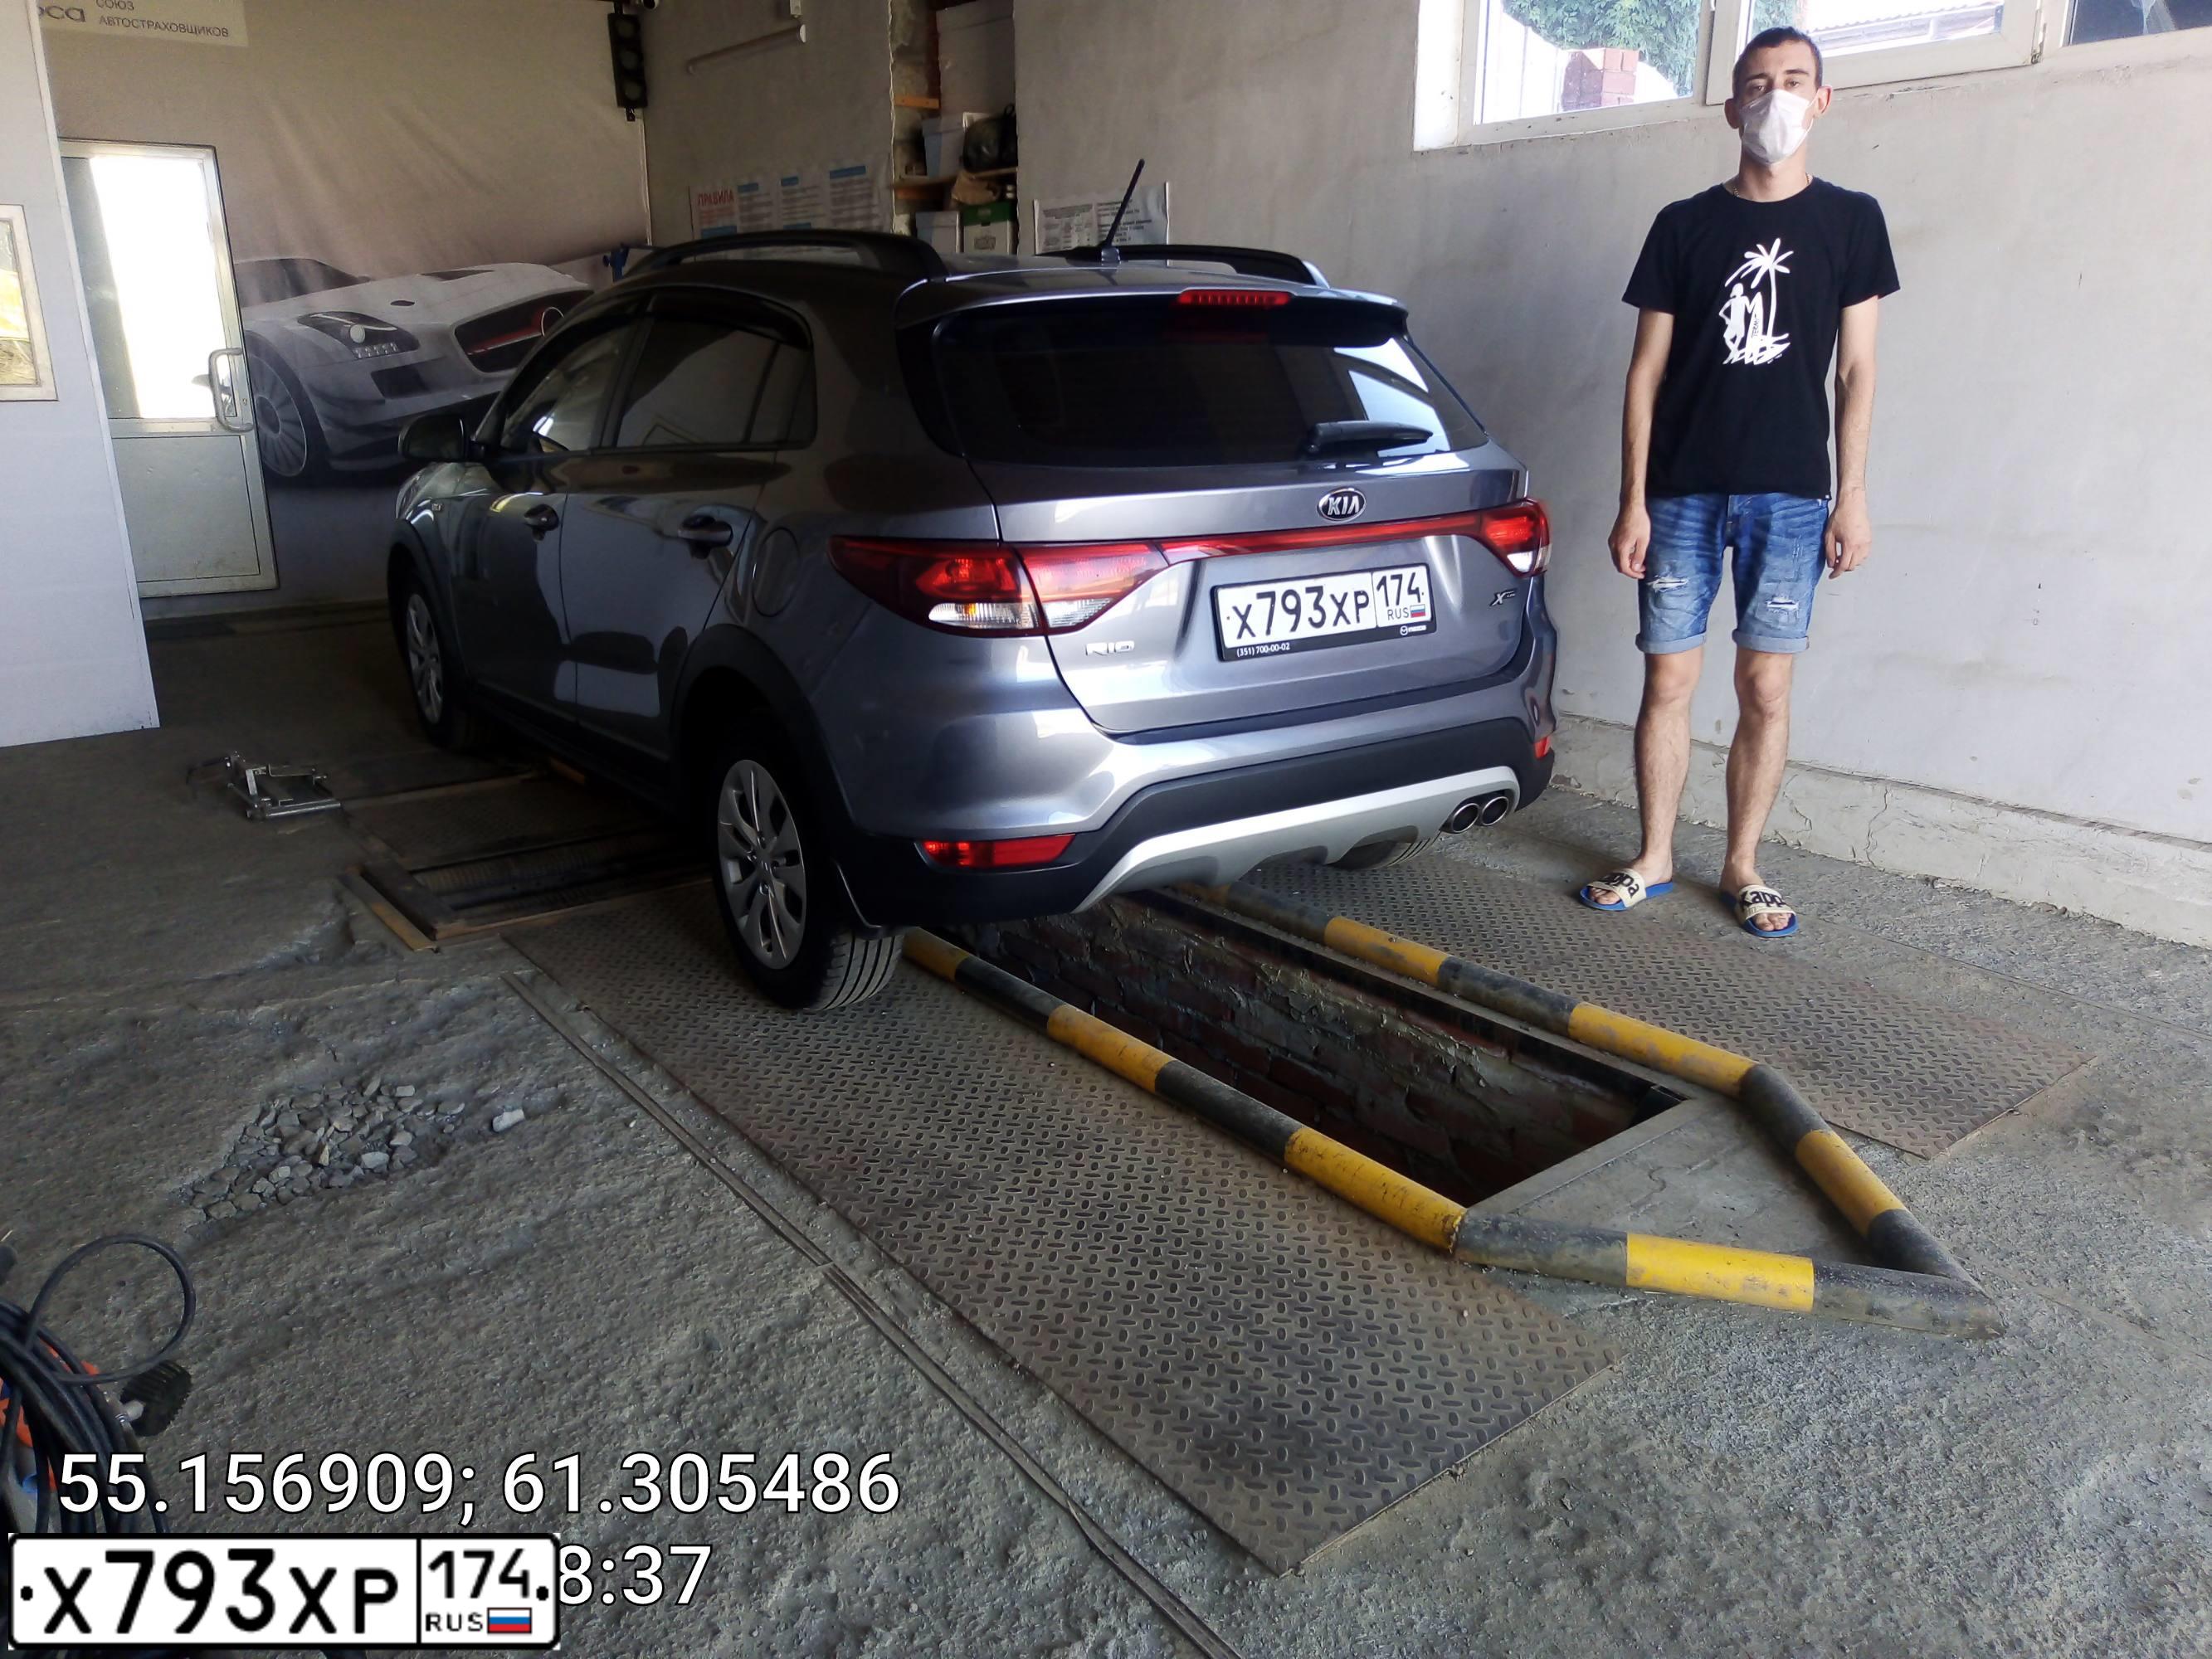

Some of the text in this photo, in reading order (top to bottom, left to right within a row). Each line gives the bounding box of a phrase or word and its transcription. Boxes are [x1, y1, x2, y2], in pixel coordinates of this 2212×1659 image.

[39, 5, 85, 23] са
[95, 0, 134, 11] СОЮЗ
[99, 16, 229, 37] АВТОСТРАХОВЩИКОВ
[697, 189, 733, 207] ПРАВИЛА
[1328, 495, 1360, 516] KIA
[1232, 572, 1421, 640] Х793ХР 174
[1387, 608, 1410, 620] RUS
[1084, 640, 1135, 657] RIO
[1236, 642, 1291, 657] (351) 700-00-02
